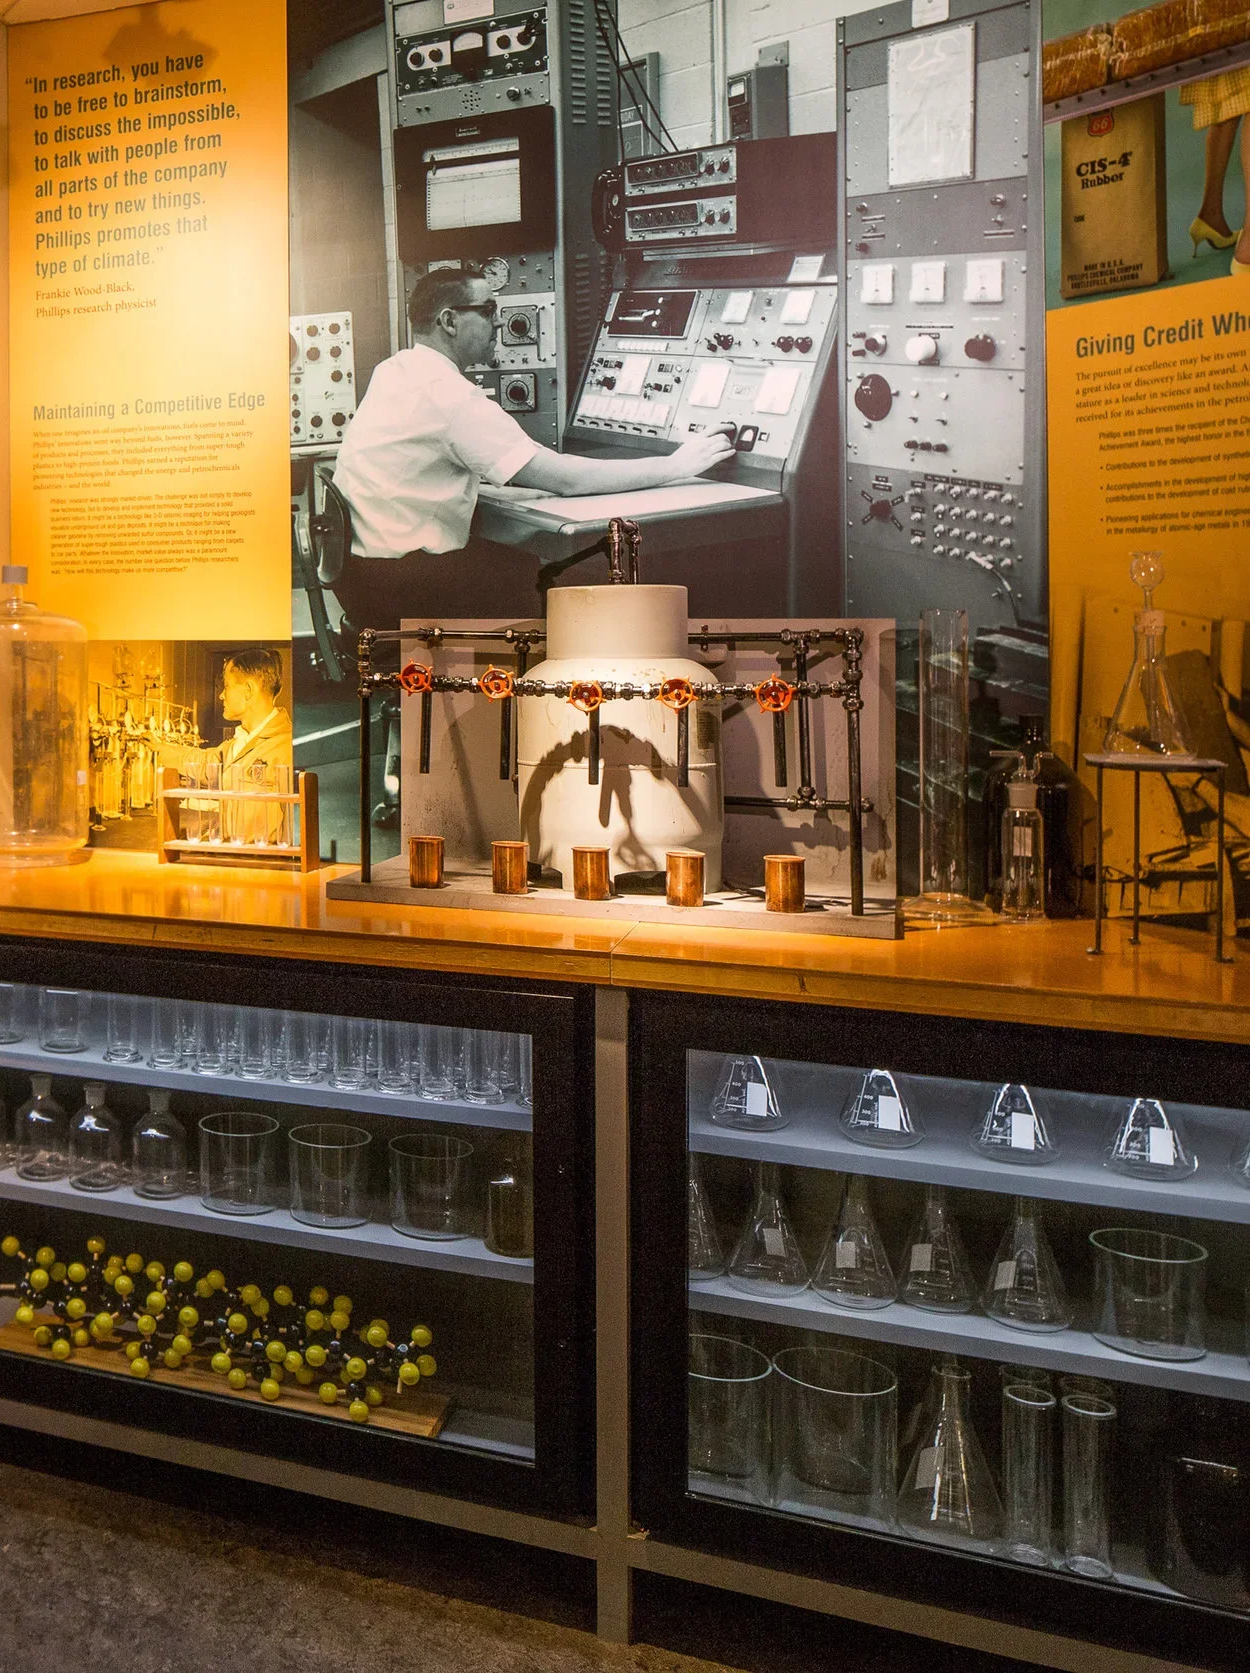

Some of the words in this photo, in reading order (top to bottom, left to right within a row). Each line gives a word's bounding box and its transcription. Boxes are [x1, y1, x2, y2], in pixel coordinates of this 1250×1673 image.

[53, 64, 125, 91] research,
[131, 61, 158, 81] you
[165, 54, 203, 73] have
[34, 103, 48, 120] to
[54, 99, 71, 116] be
[77, 96, 107, 113] free
[114, 91, 127, 107] to
[134, 79, 226, 104] brainstorm,
[34, 129, 48, 146] to
[54, 122, 111, 143] discuss
[117, 116, 141, 133] the
[147, 102, 240, 129] impossible,
[34, 155, 48, 172] to
[54, 149, 81, 169] talk
[87, 144, 118, 164] with
[125, 137, 177, 162] people
[184, 134, 220, 151] from
[1076, 151, 1131, 177] CIS-4
[35, 180, 52, 198] all
[59, 175, 97, 198] parts
[104, 171, 118, 189] of
[124, 169, 147, 186] the
[154, 160, 227, 182] company
[1081, 172, 1125, 190] Rubber
[35, 205, 61, 224] and
[68, 204, 81, 220] to
[88, 201, 108, 219] try
[115, 198, 146, 214] new
[152, 191, 205, 209] things.
[35, 230, 90, 250] Phillips
[97, 221, 170, 246] promotes
[176, 214, 208, 234] that
[35, 260, 66, 279] type
[73, 255, 86, 272] of
[35, 306, 70, 318] Phillips
[73, 301, 111, 314] research
[115, 296, 157, 312] physicist
[1076, 333, 1134, 358] Giving
[1143, 319, 1203, 347] Credit
[1211, 312, 1250, 335] Wh
[1076, 372, 1091, 381] The
[1092, 367, 1121, 381] pursuit
[1123, 365, 1132, 374] of
[1134, 360, 1177, 372] excellence
[1179, 357, 1197, 366] may
[1200, 354, 1211, 362] be
[1213, 352, 1224, 360] its
[1226, 350, 1246, 358] own
[33, 401, 114, 420] Maintaining
[121, 402, 128, 415] a
[134, 394, 221, 415] Competitive
[228, 392, 264, 410] Edge
